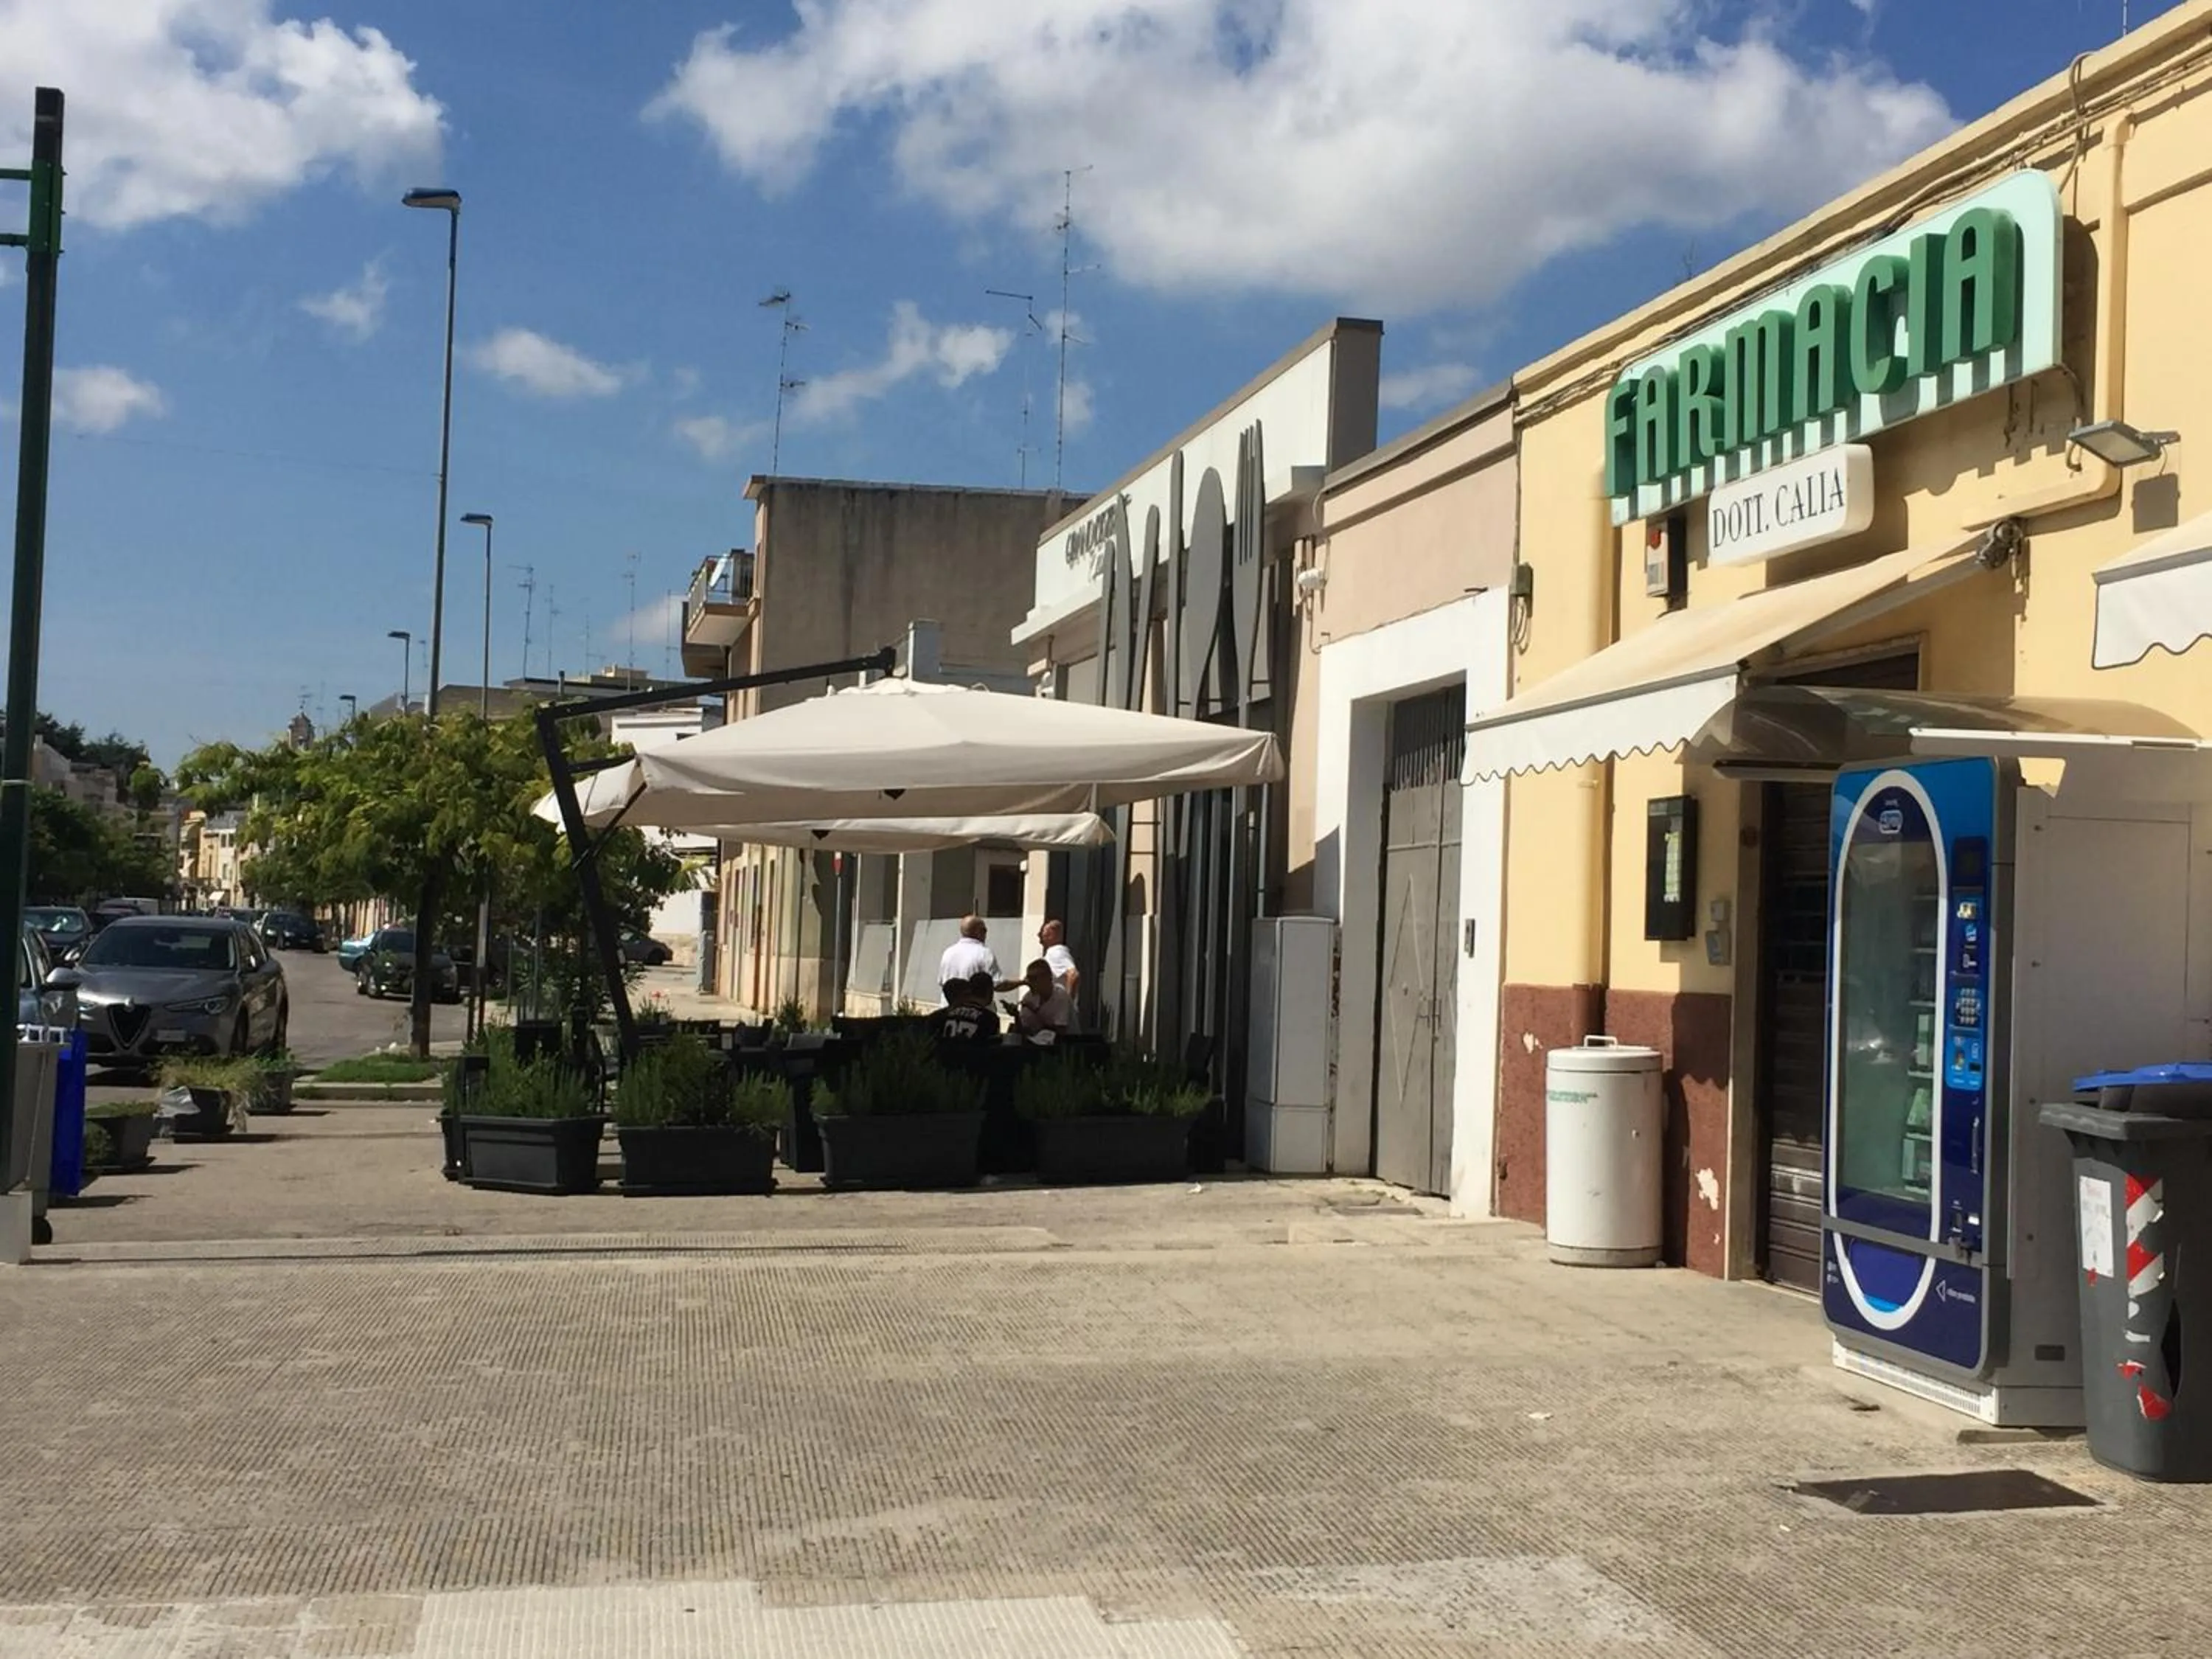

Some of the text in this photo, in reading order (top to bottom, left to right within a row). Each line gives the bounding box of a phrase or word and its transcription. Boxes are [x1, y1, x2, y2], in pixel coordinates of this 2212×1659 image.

[1605, 207, 2017, 496] FARMACIA
[1713, 467, 1844, 548] DOTT. CALIA
